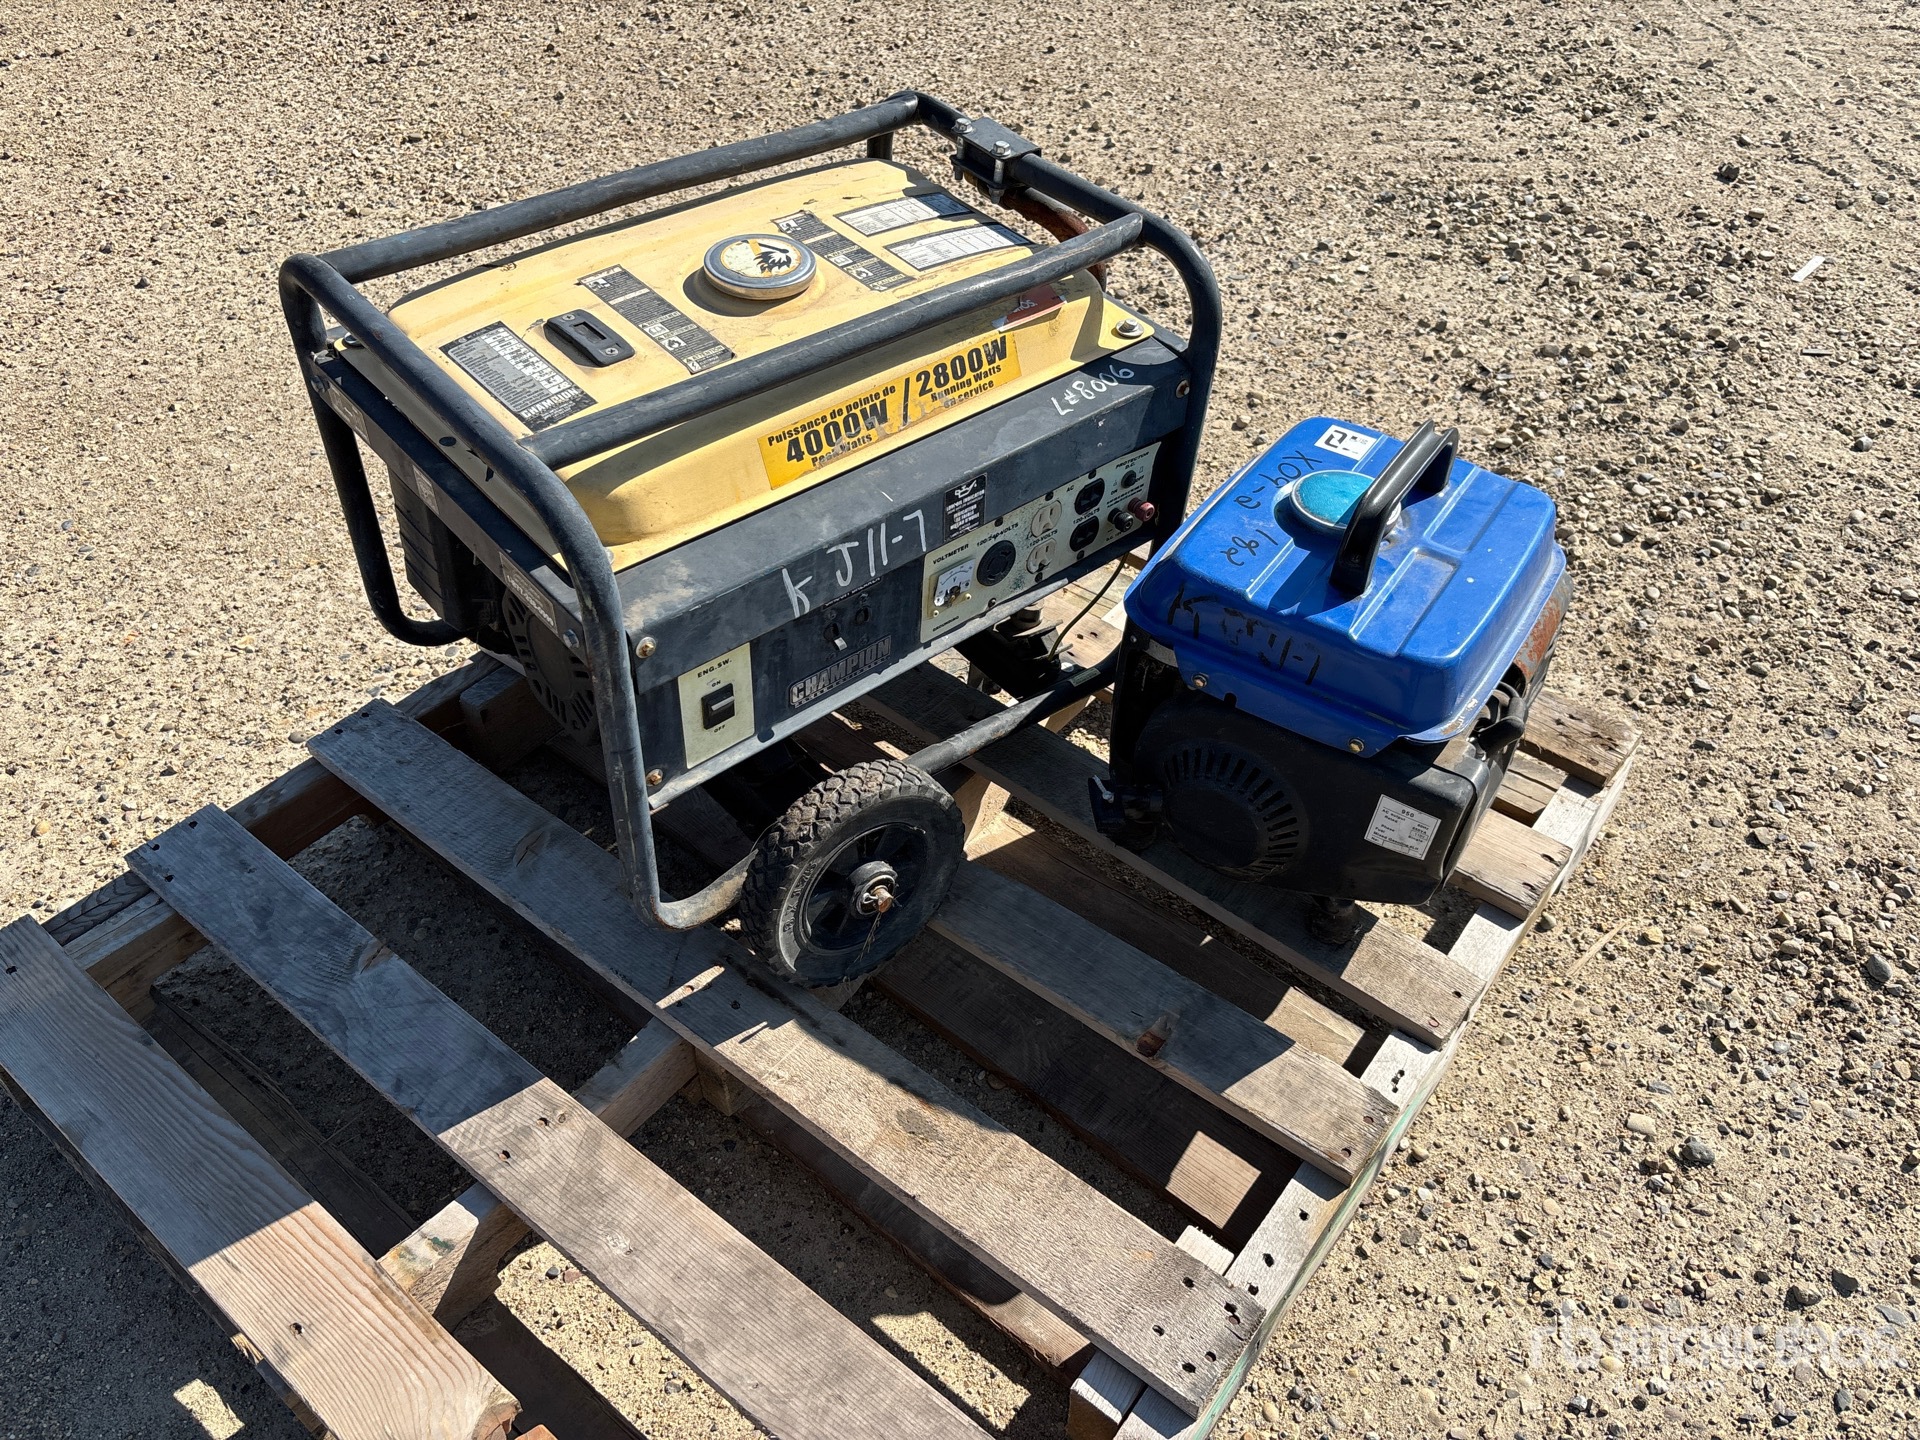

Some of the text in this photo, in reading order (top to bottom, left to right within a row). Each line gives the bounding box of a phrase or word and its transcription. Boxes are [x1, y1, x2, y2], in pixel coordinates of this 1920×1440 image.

[973, 364, 1002, 383] Watts
[786, 398, 889, 463] 4000W
[916, 335, 1007, 398] 2800W
[958, 380, 995, 403] service
[519, 387, 580, 419] CHAMPION
[768, 385, 896, 447] Puissance de pointe de
[933, 543, 969, 565] VOLTMETER
[697, 658, 733, 678] ENG.SW.
[791, 635, 891, 705] CHAMPION
[711, 680, 721, 688] ON
[713, 724, 726, 733] OFF
[1401, 809, 1415, 818] 950
